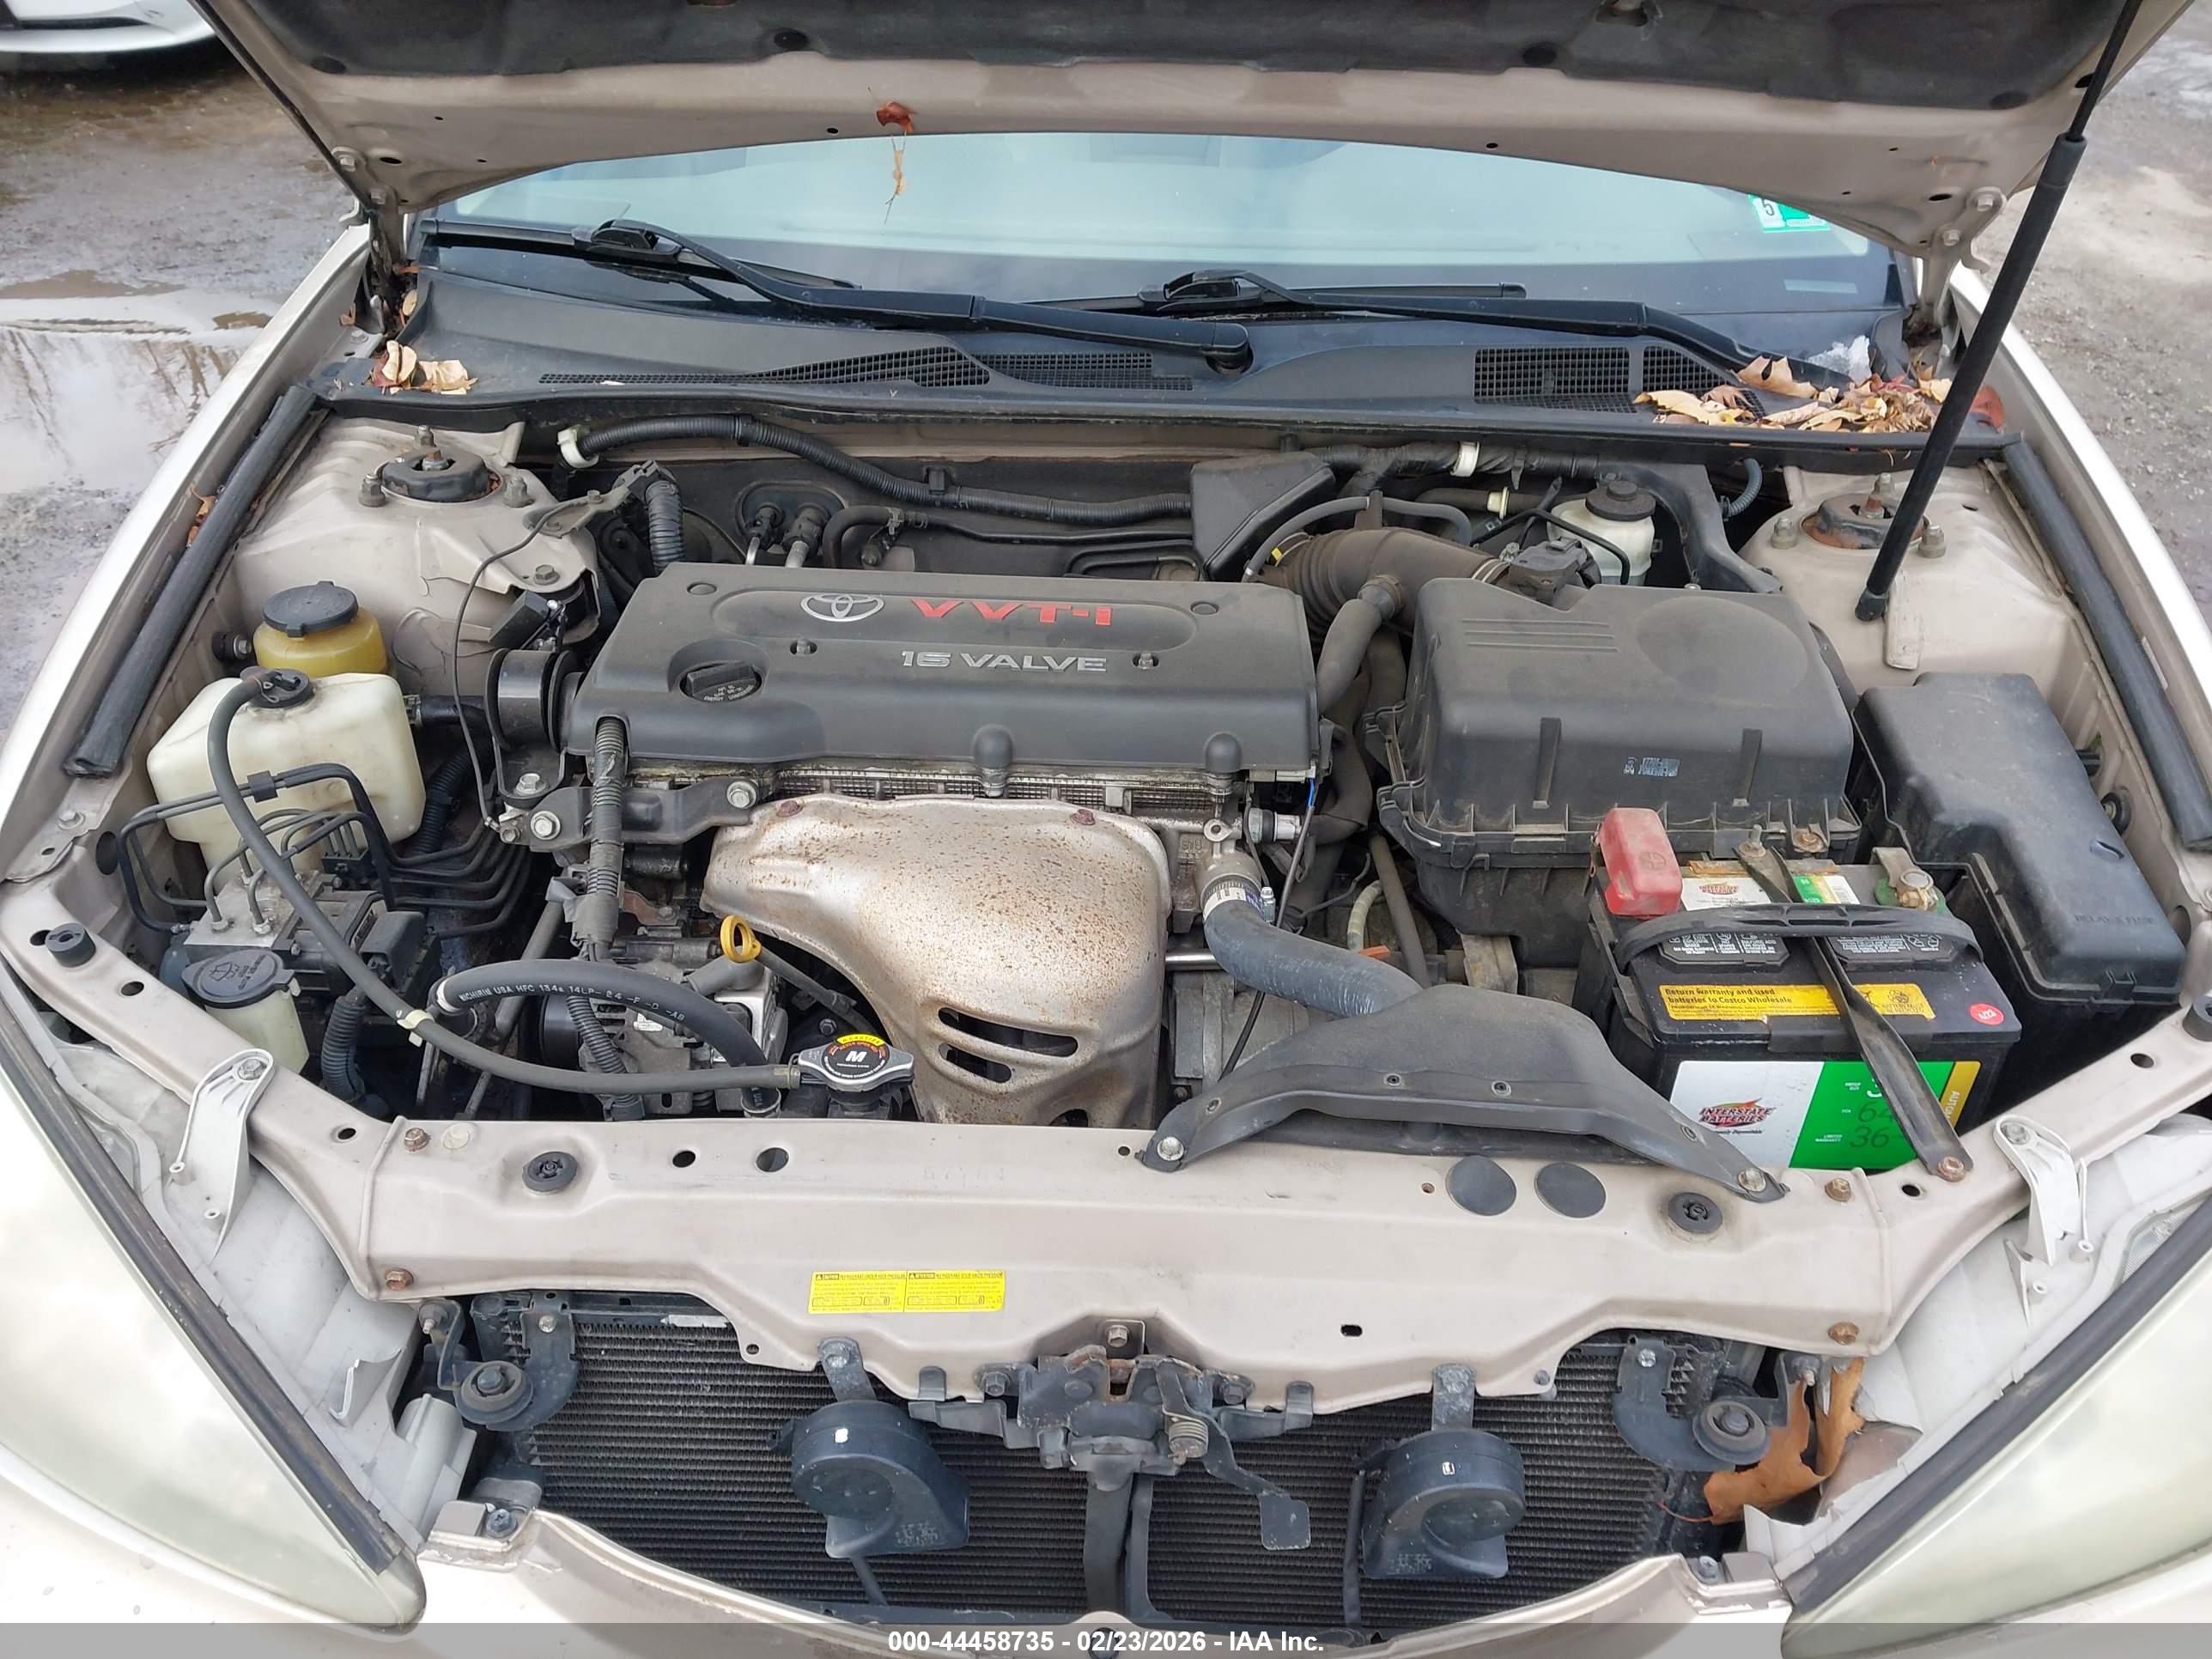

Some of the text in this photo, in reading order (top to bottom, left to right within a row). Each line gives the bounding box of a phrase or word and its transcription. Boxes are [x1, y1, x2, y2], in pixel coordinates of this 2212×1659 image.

[902, 651, 1107, 672] 16 VALVE
[494, 987, 513, 995] USA
[516, 984, 535, 993] HFC
[845, 1050, 867, 1063] M
[1699, 1107, 1772, 1115] INTERSTATE
